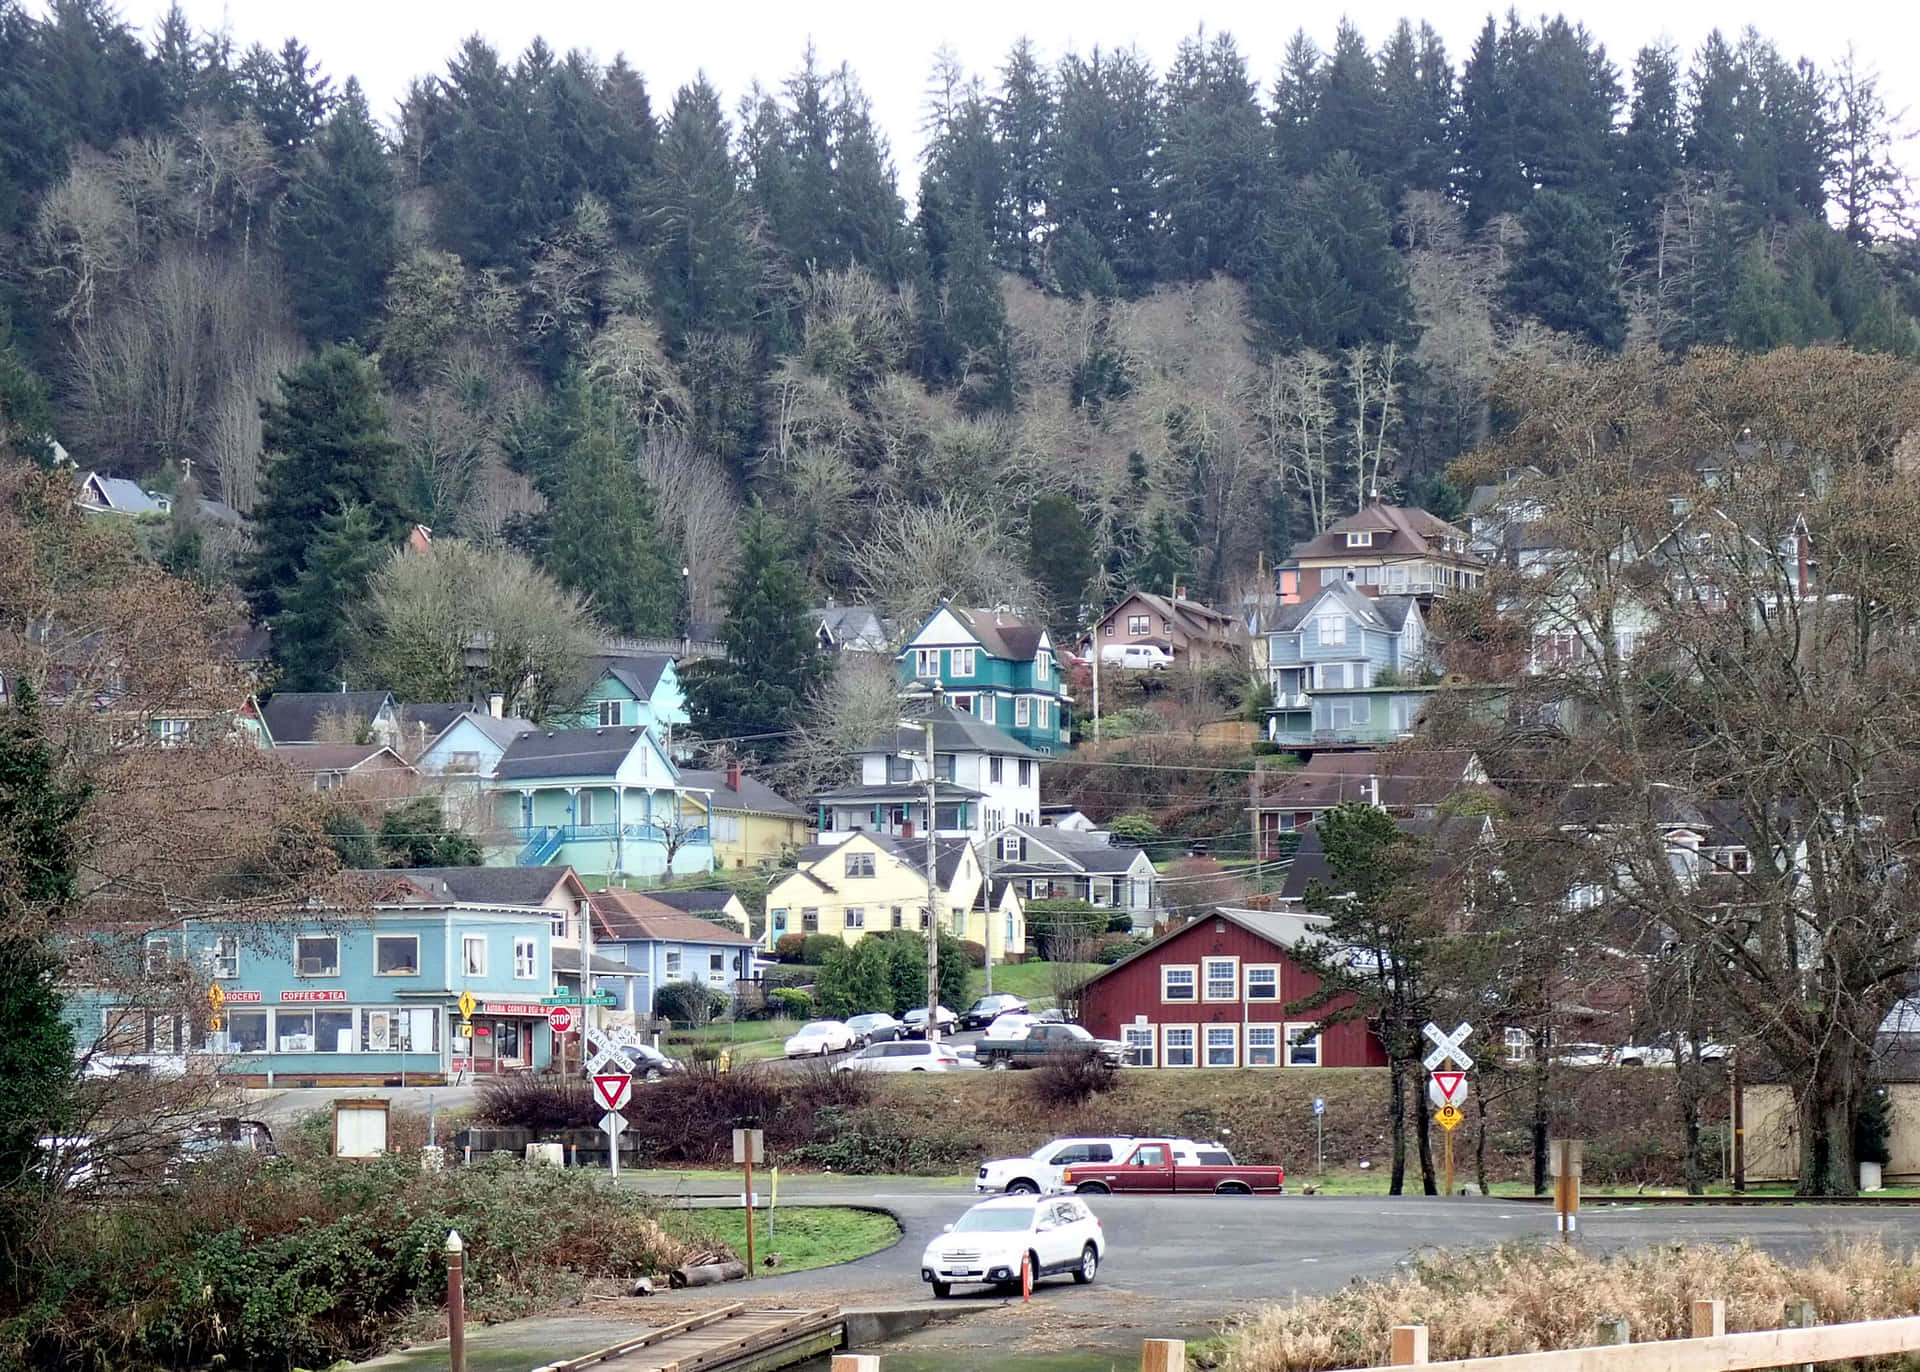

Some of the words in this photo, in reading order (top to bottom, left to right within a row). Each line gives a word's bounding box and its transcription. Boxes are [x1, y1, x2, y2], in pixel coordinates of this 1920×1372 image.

[282, 991, 315, 1000] COFFEE
[329, 991, 344, 999] TEA
[507, 1005, 527, 1014] CORNER
[550, 1014, 570, 1025] STOP
[588, 1028, 607, 1049] RAIL
[612, 1051, 633, 1071] ROAD
[1426, 1025, 1443, 1046] RAIL
[1451, 1048, 1471, 1068] ROAD
